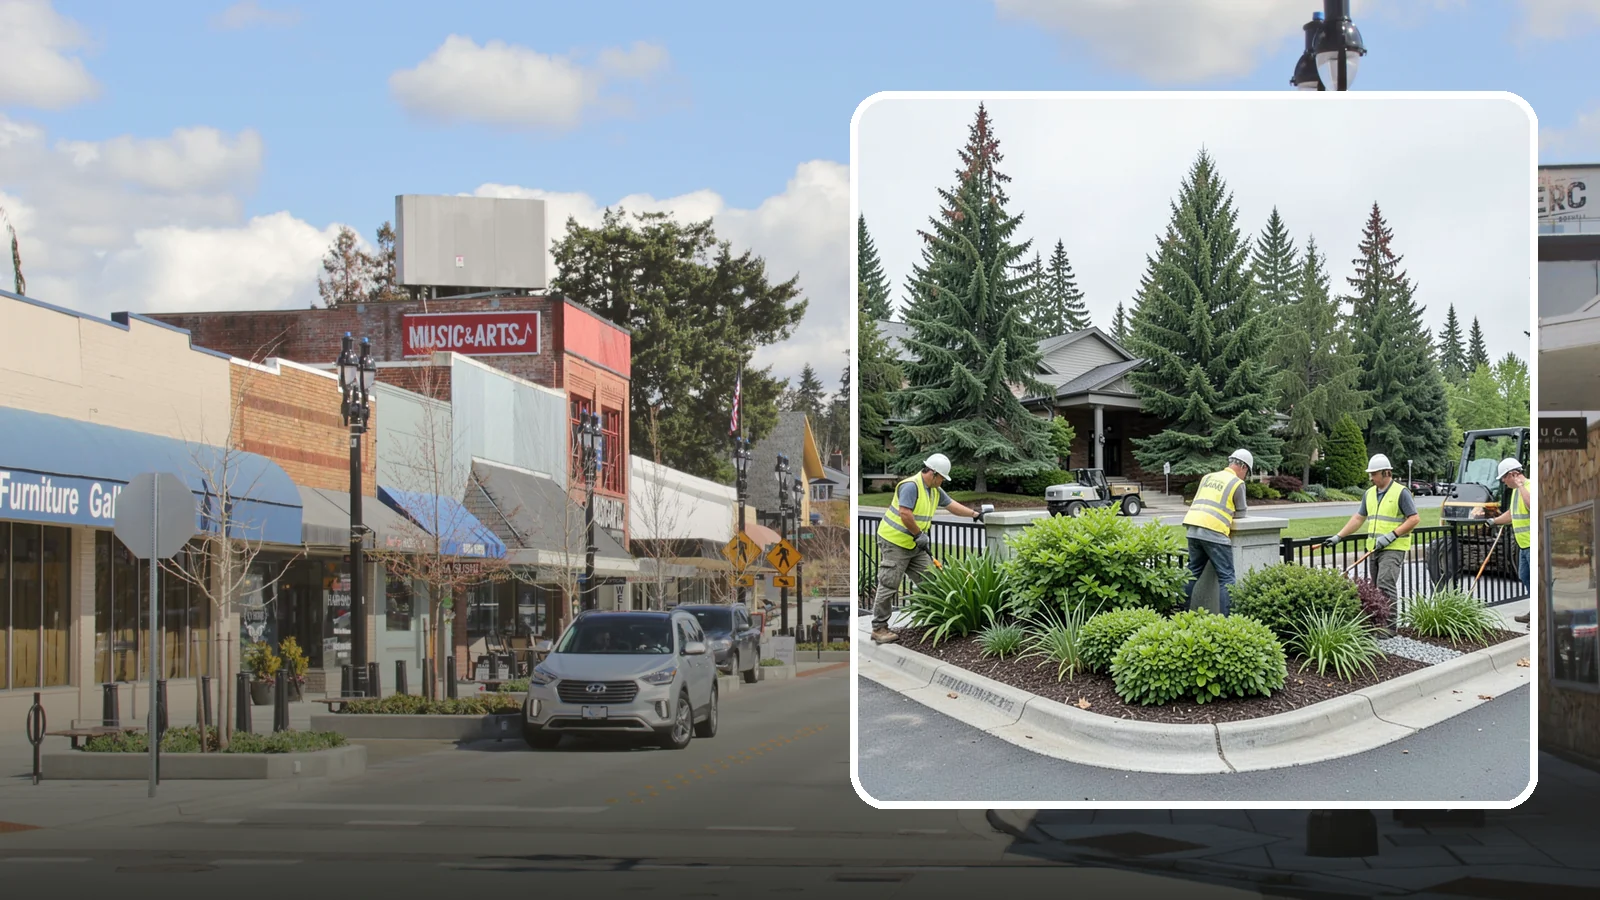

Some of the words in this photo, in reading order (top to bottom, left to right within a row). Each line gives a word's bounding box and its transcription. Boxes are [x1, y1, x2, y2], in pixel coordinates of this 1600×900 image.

[0, 471, 79, 515] Furniture
[89, 482, 122, 519] Gal
[453, 562, 480, 574] SUSHI
